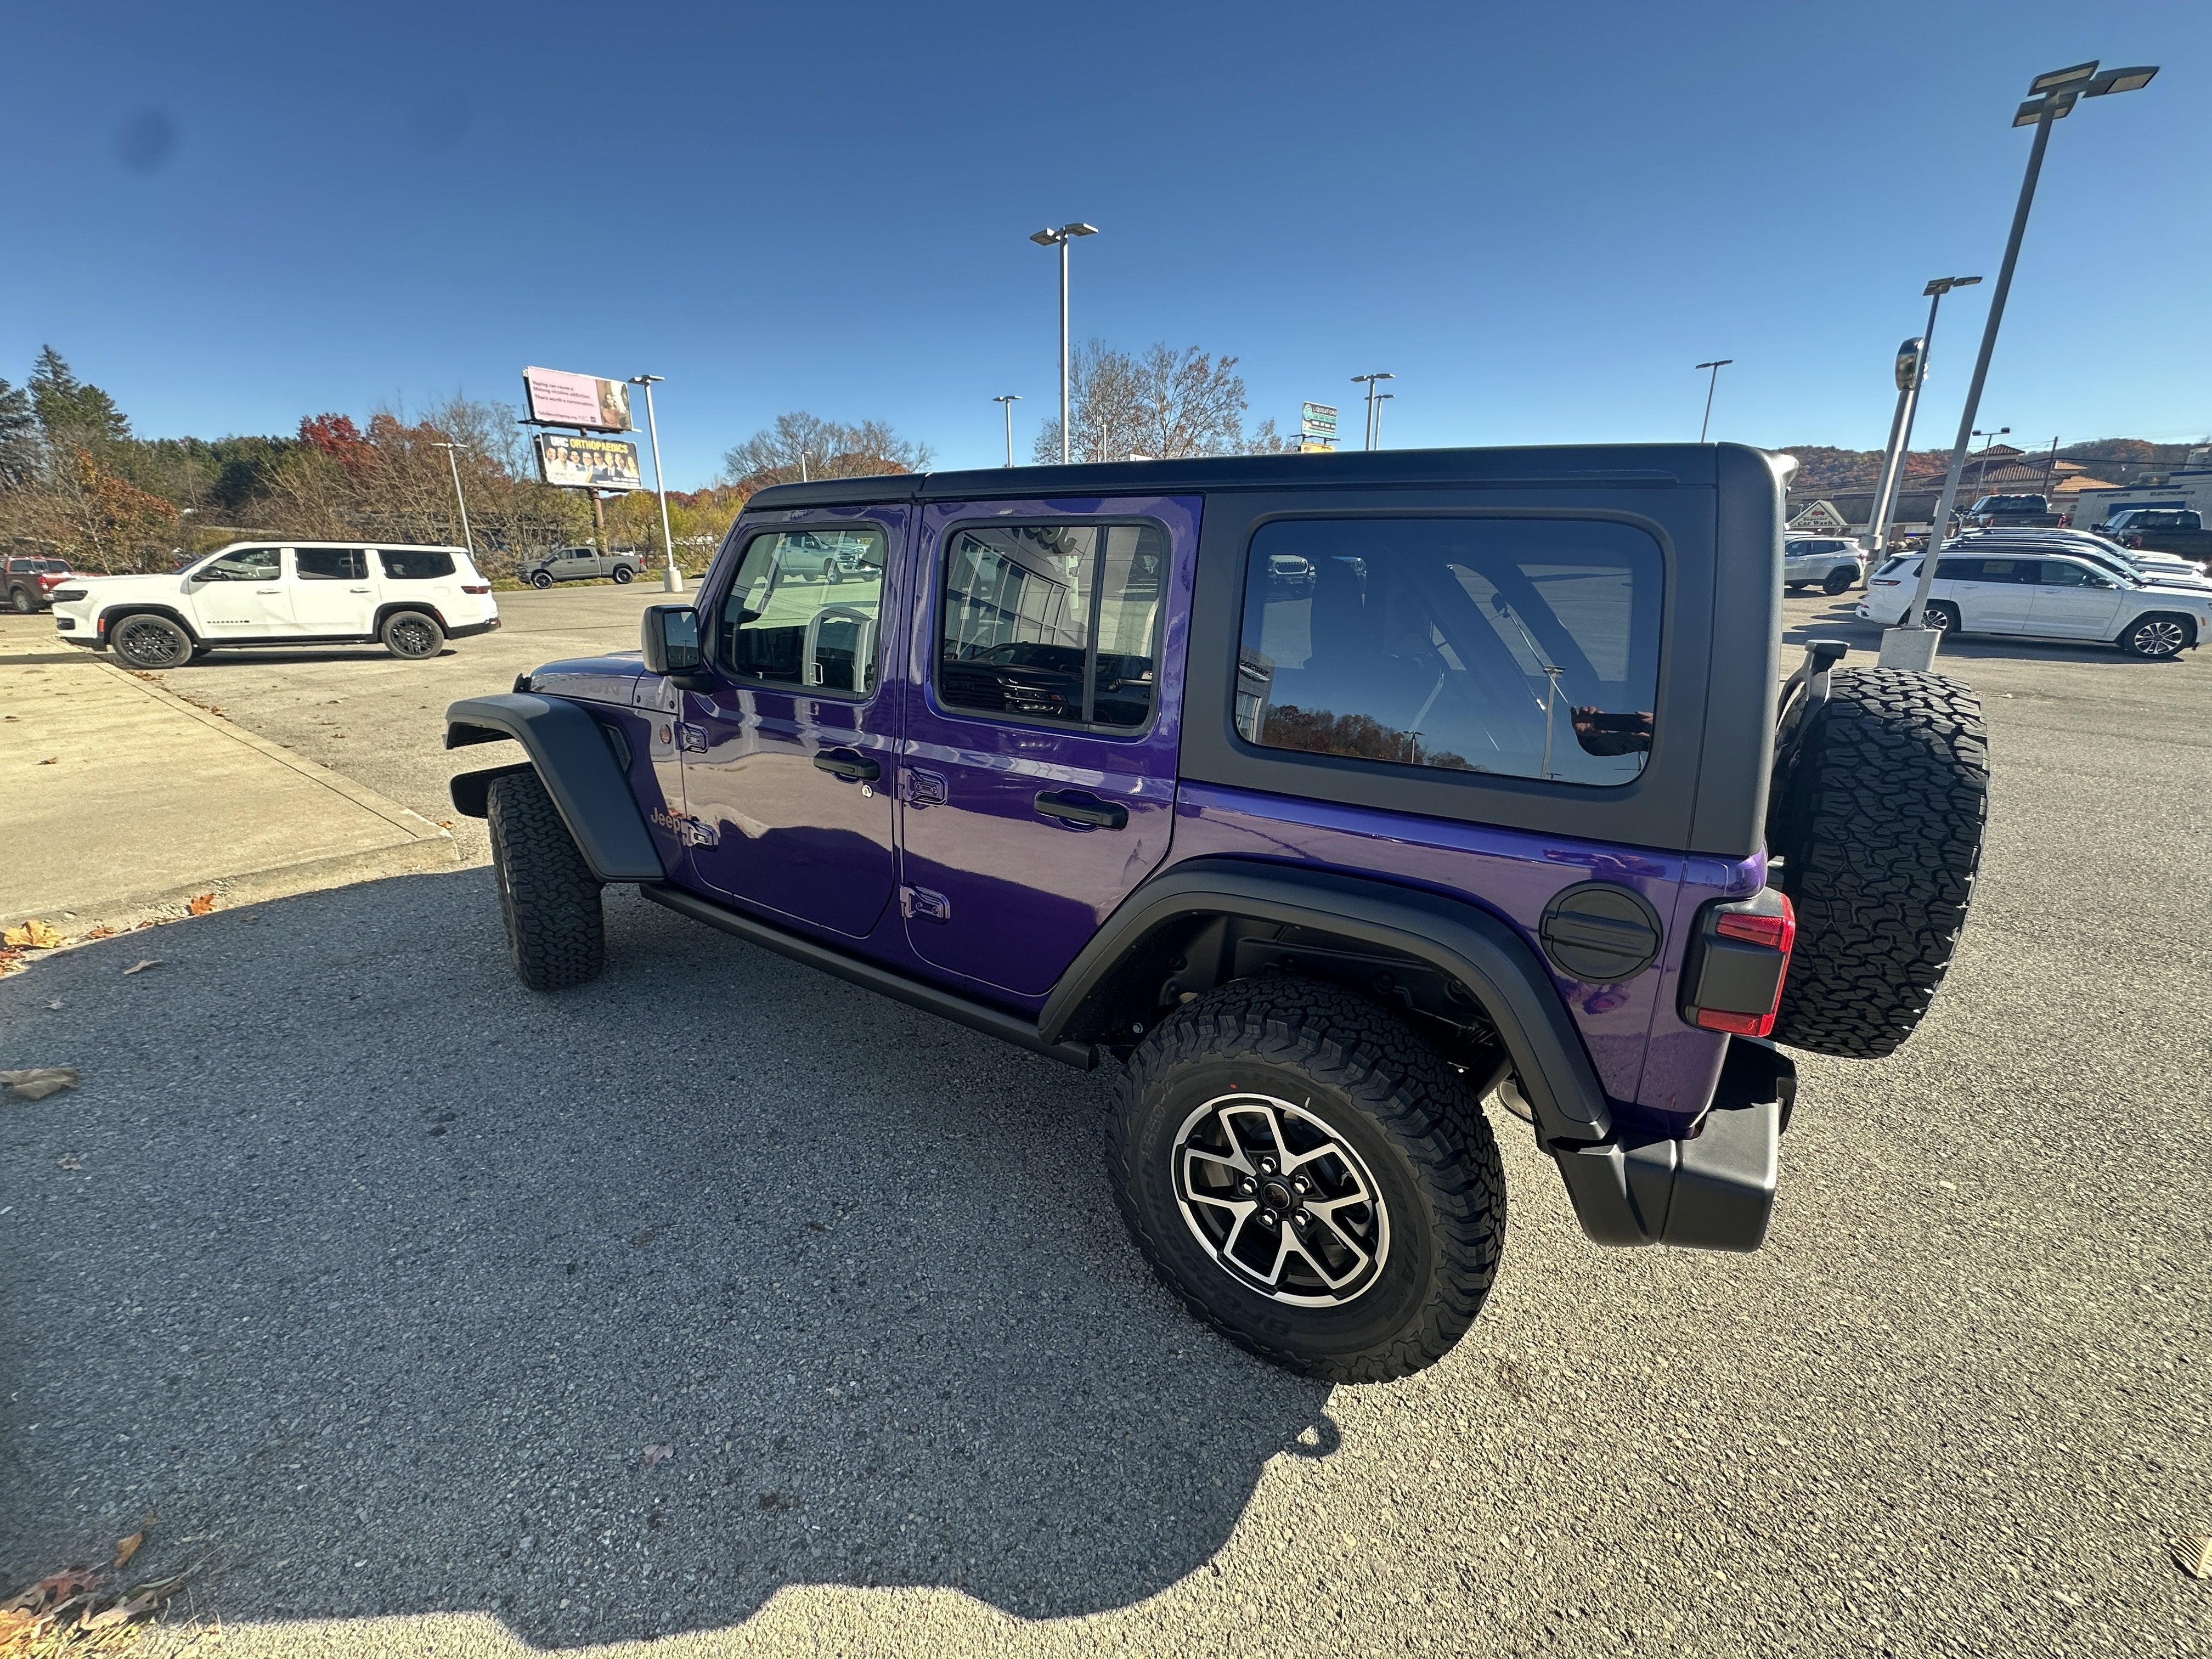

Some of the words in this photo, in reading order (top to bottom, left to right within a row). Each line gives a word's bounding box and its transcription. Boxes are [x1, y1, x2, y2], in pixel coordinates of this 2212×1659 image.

[550, 436, 568, 447] UHC
[570, 438, 628, 454] ORTHOPAEDICS
[650, 807, 681, 834] Jeep
